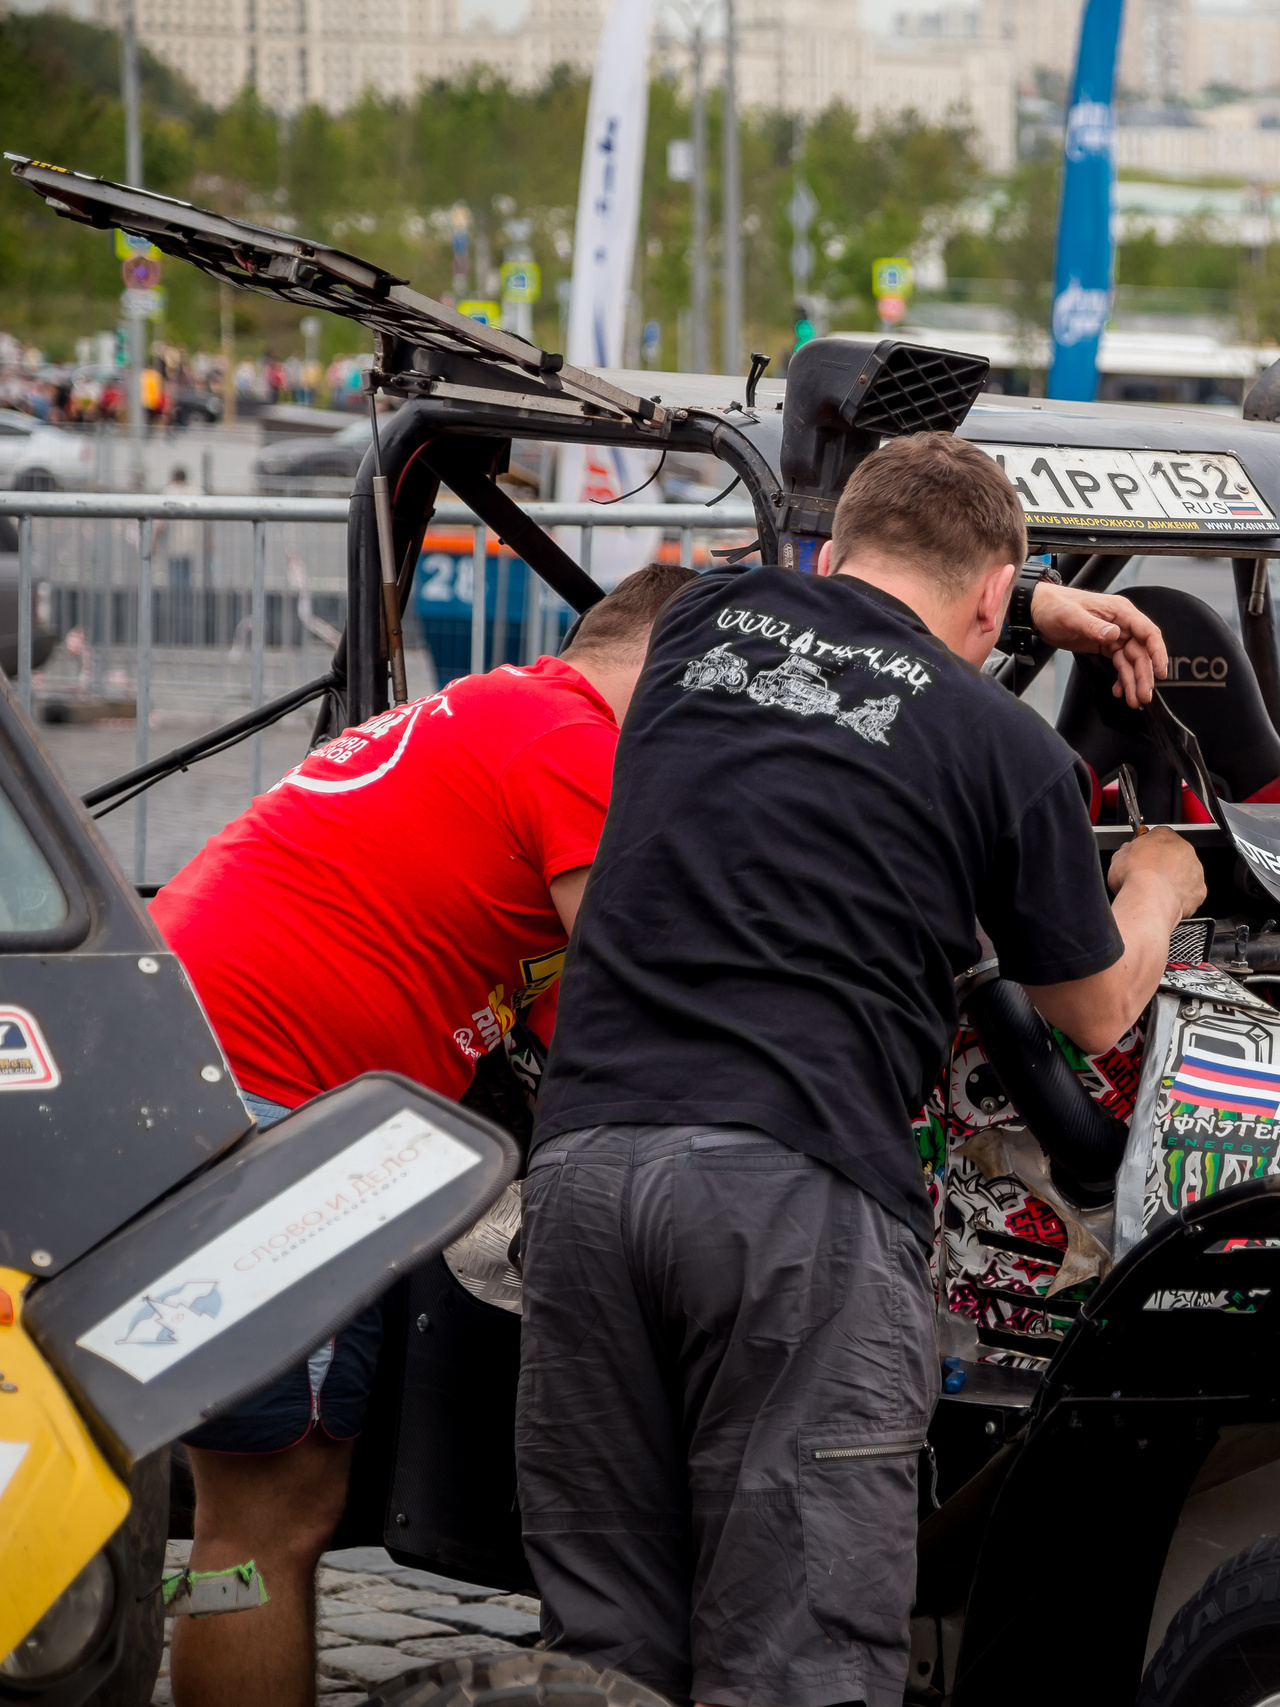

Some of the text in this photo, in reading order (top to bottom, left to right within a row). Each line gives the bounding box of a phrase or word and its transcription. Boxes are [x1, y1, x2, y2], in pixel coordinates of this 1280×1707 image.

[1150, 460, 1243, 500] 152
[1183, 501, 1228, 514] RUS
[1033, 514, 1061, 525] КЛУБ
[1060, 516, 1145, 529] ВНЕДОРОЖНОГО
[1147, 521, 1200, 530] ДВИЖЕНИЯ
[1167, 1137, 1272, 1154] ENERGY
[233, 1147, 419, 1272] СЛОВО И ДЕЛО
